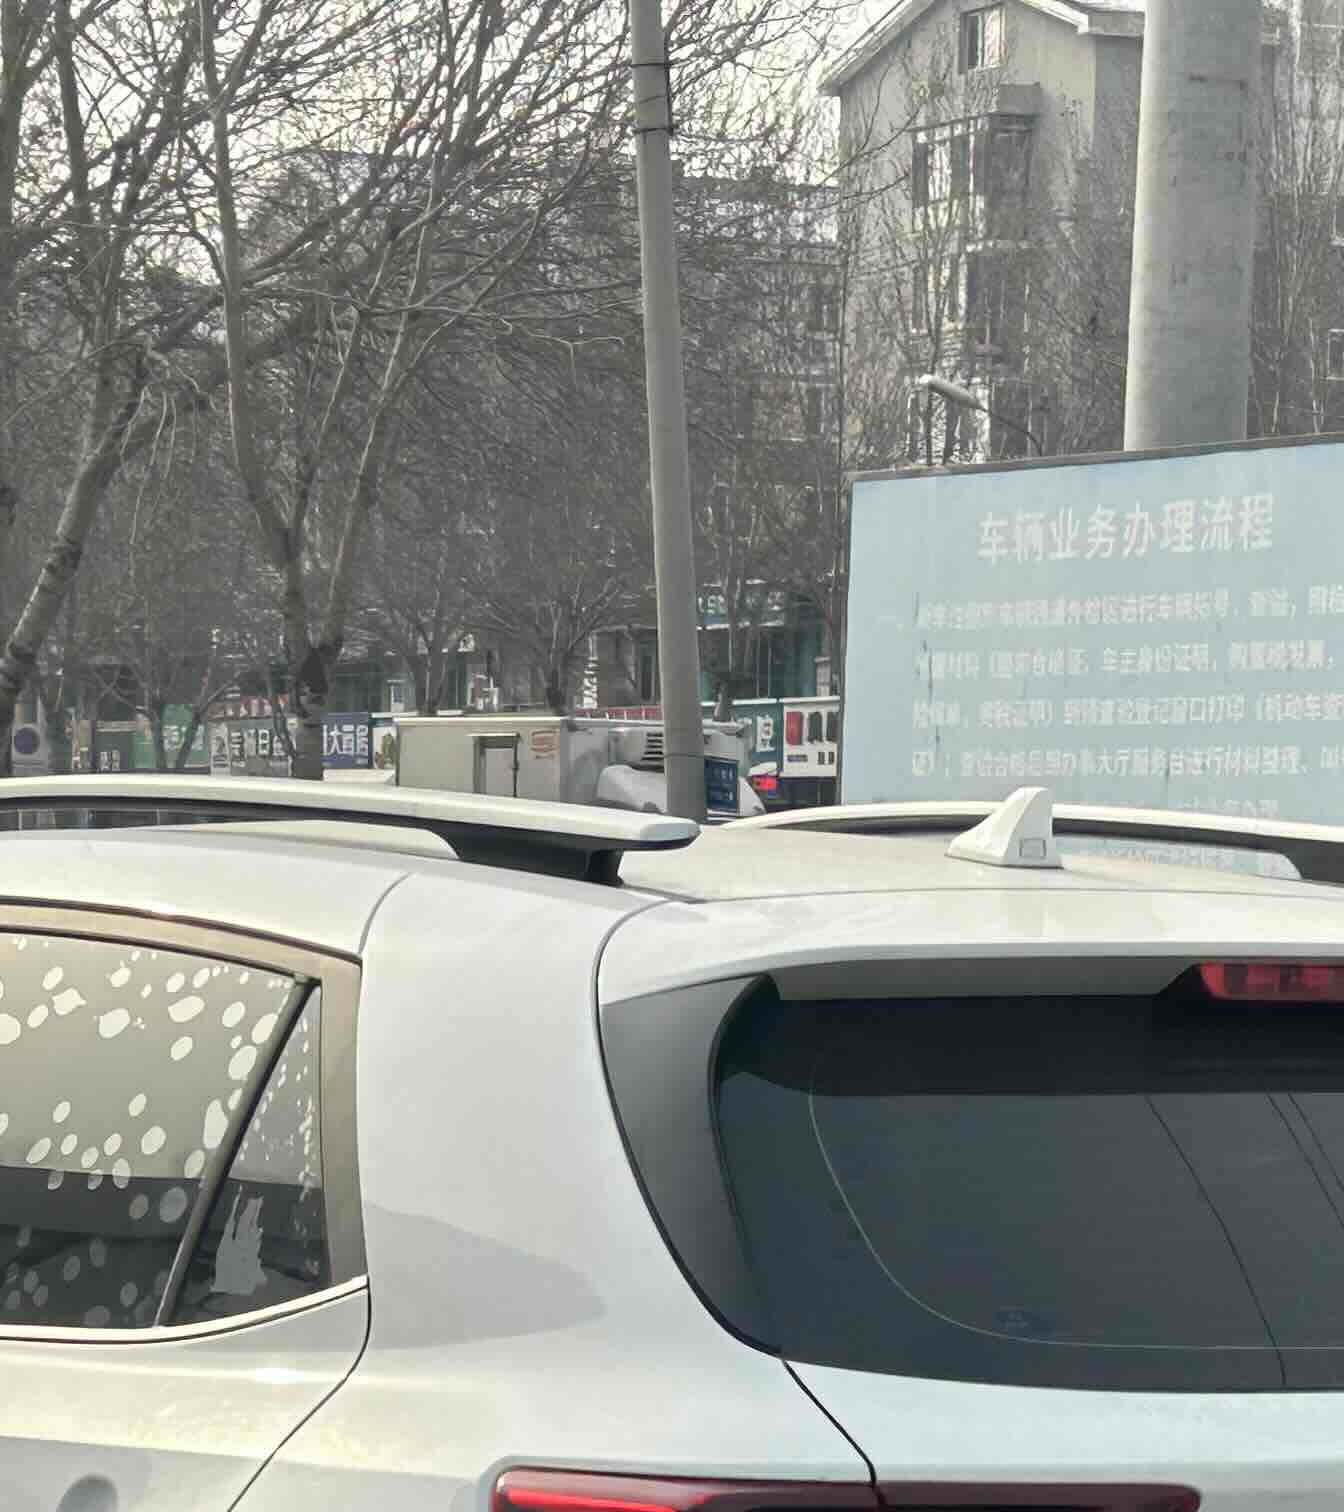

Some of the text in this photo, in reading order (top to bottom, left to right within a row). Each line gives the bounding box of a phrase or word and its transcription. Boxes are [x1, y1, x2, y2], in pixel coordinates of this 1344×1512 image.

[977, 493, 1274, 564] 车辆业务办理流程
